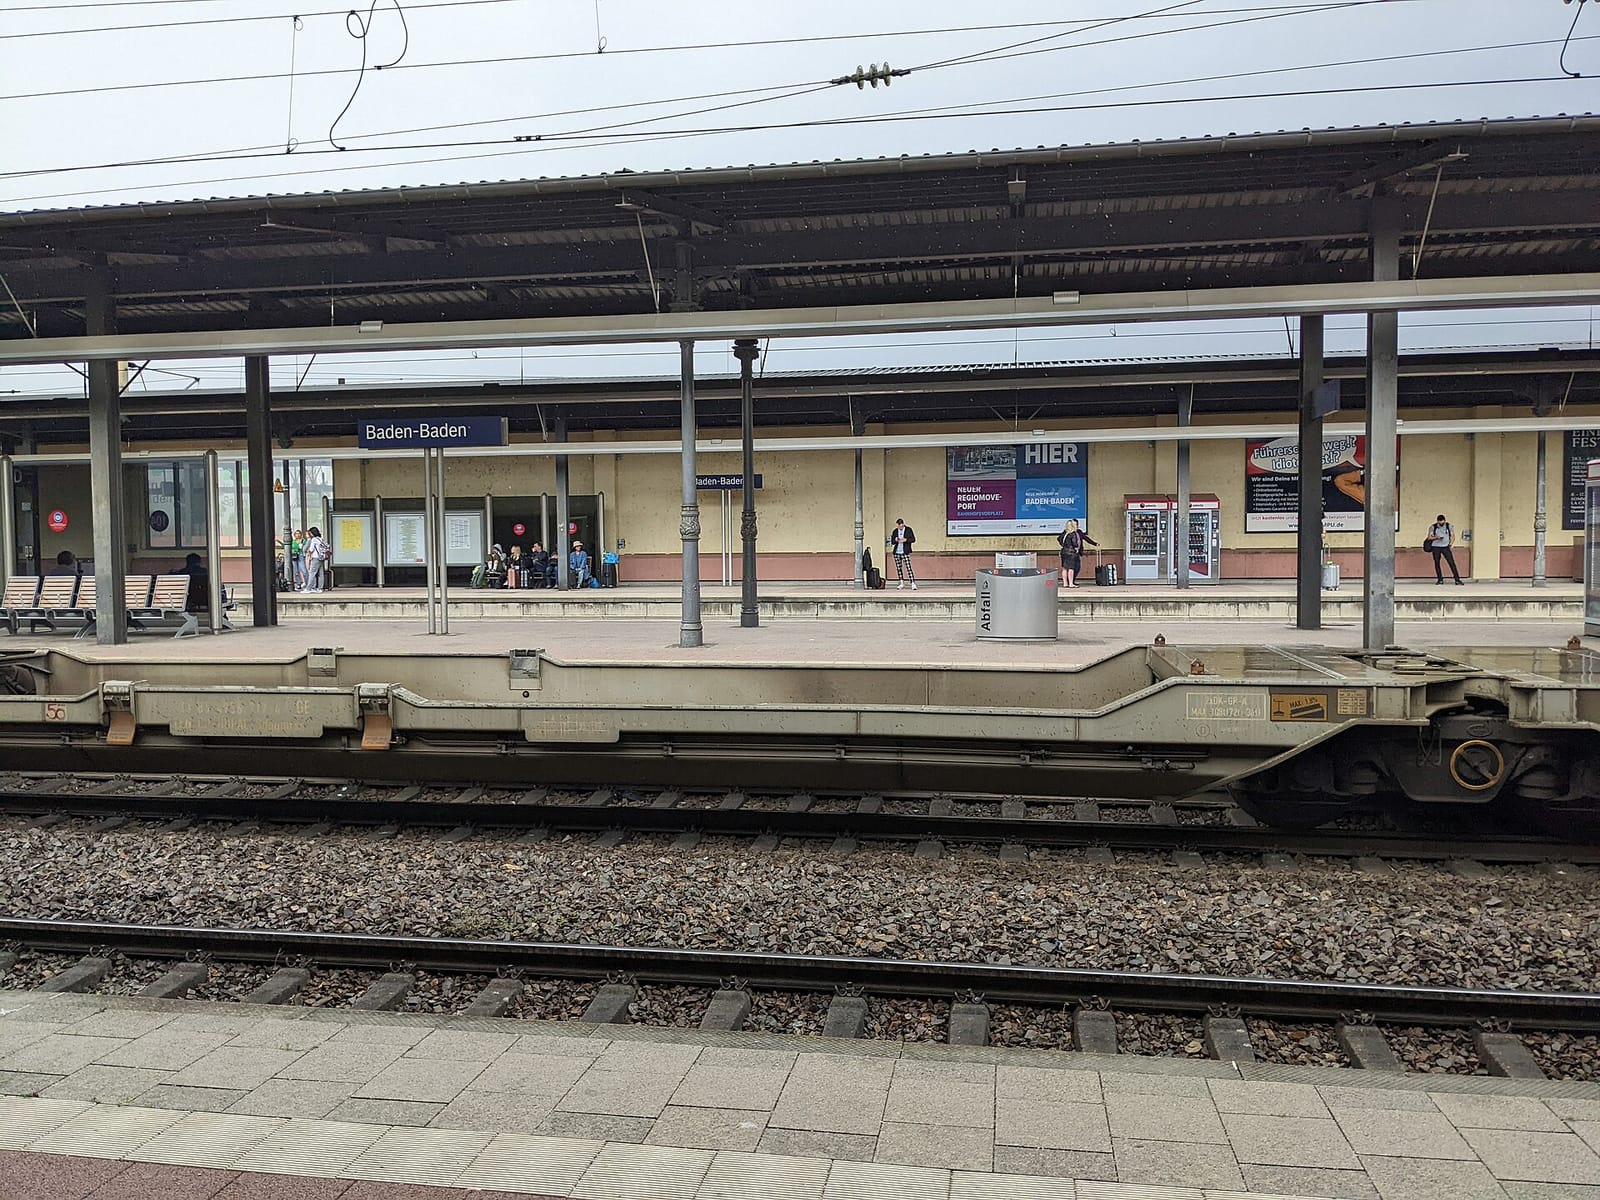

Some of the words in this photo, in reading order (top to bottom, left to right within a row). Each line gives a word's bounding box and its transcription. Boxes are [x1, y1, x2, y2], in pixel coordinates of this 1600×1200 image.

[366, 423, 467, 440] Baden-Baden
[1253, 446, 1299, 459] Führersc
[1323, 436, 1357, 451] weg!?
[1573, 437, 1600, 448] FES
[1025, 443, 1079, 465] HIER
[957, 493, 1002, 502] REGIOMOVE-
[1025, 497, 1075, 505] BADEN-BADEN
[957, 502, 977, 510] PORT
[980, 592, 991, 632] Abfall
